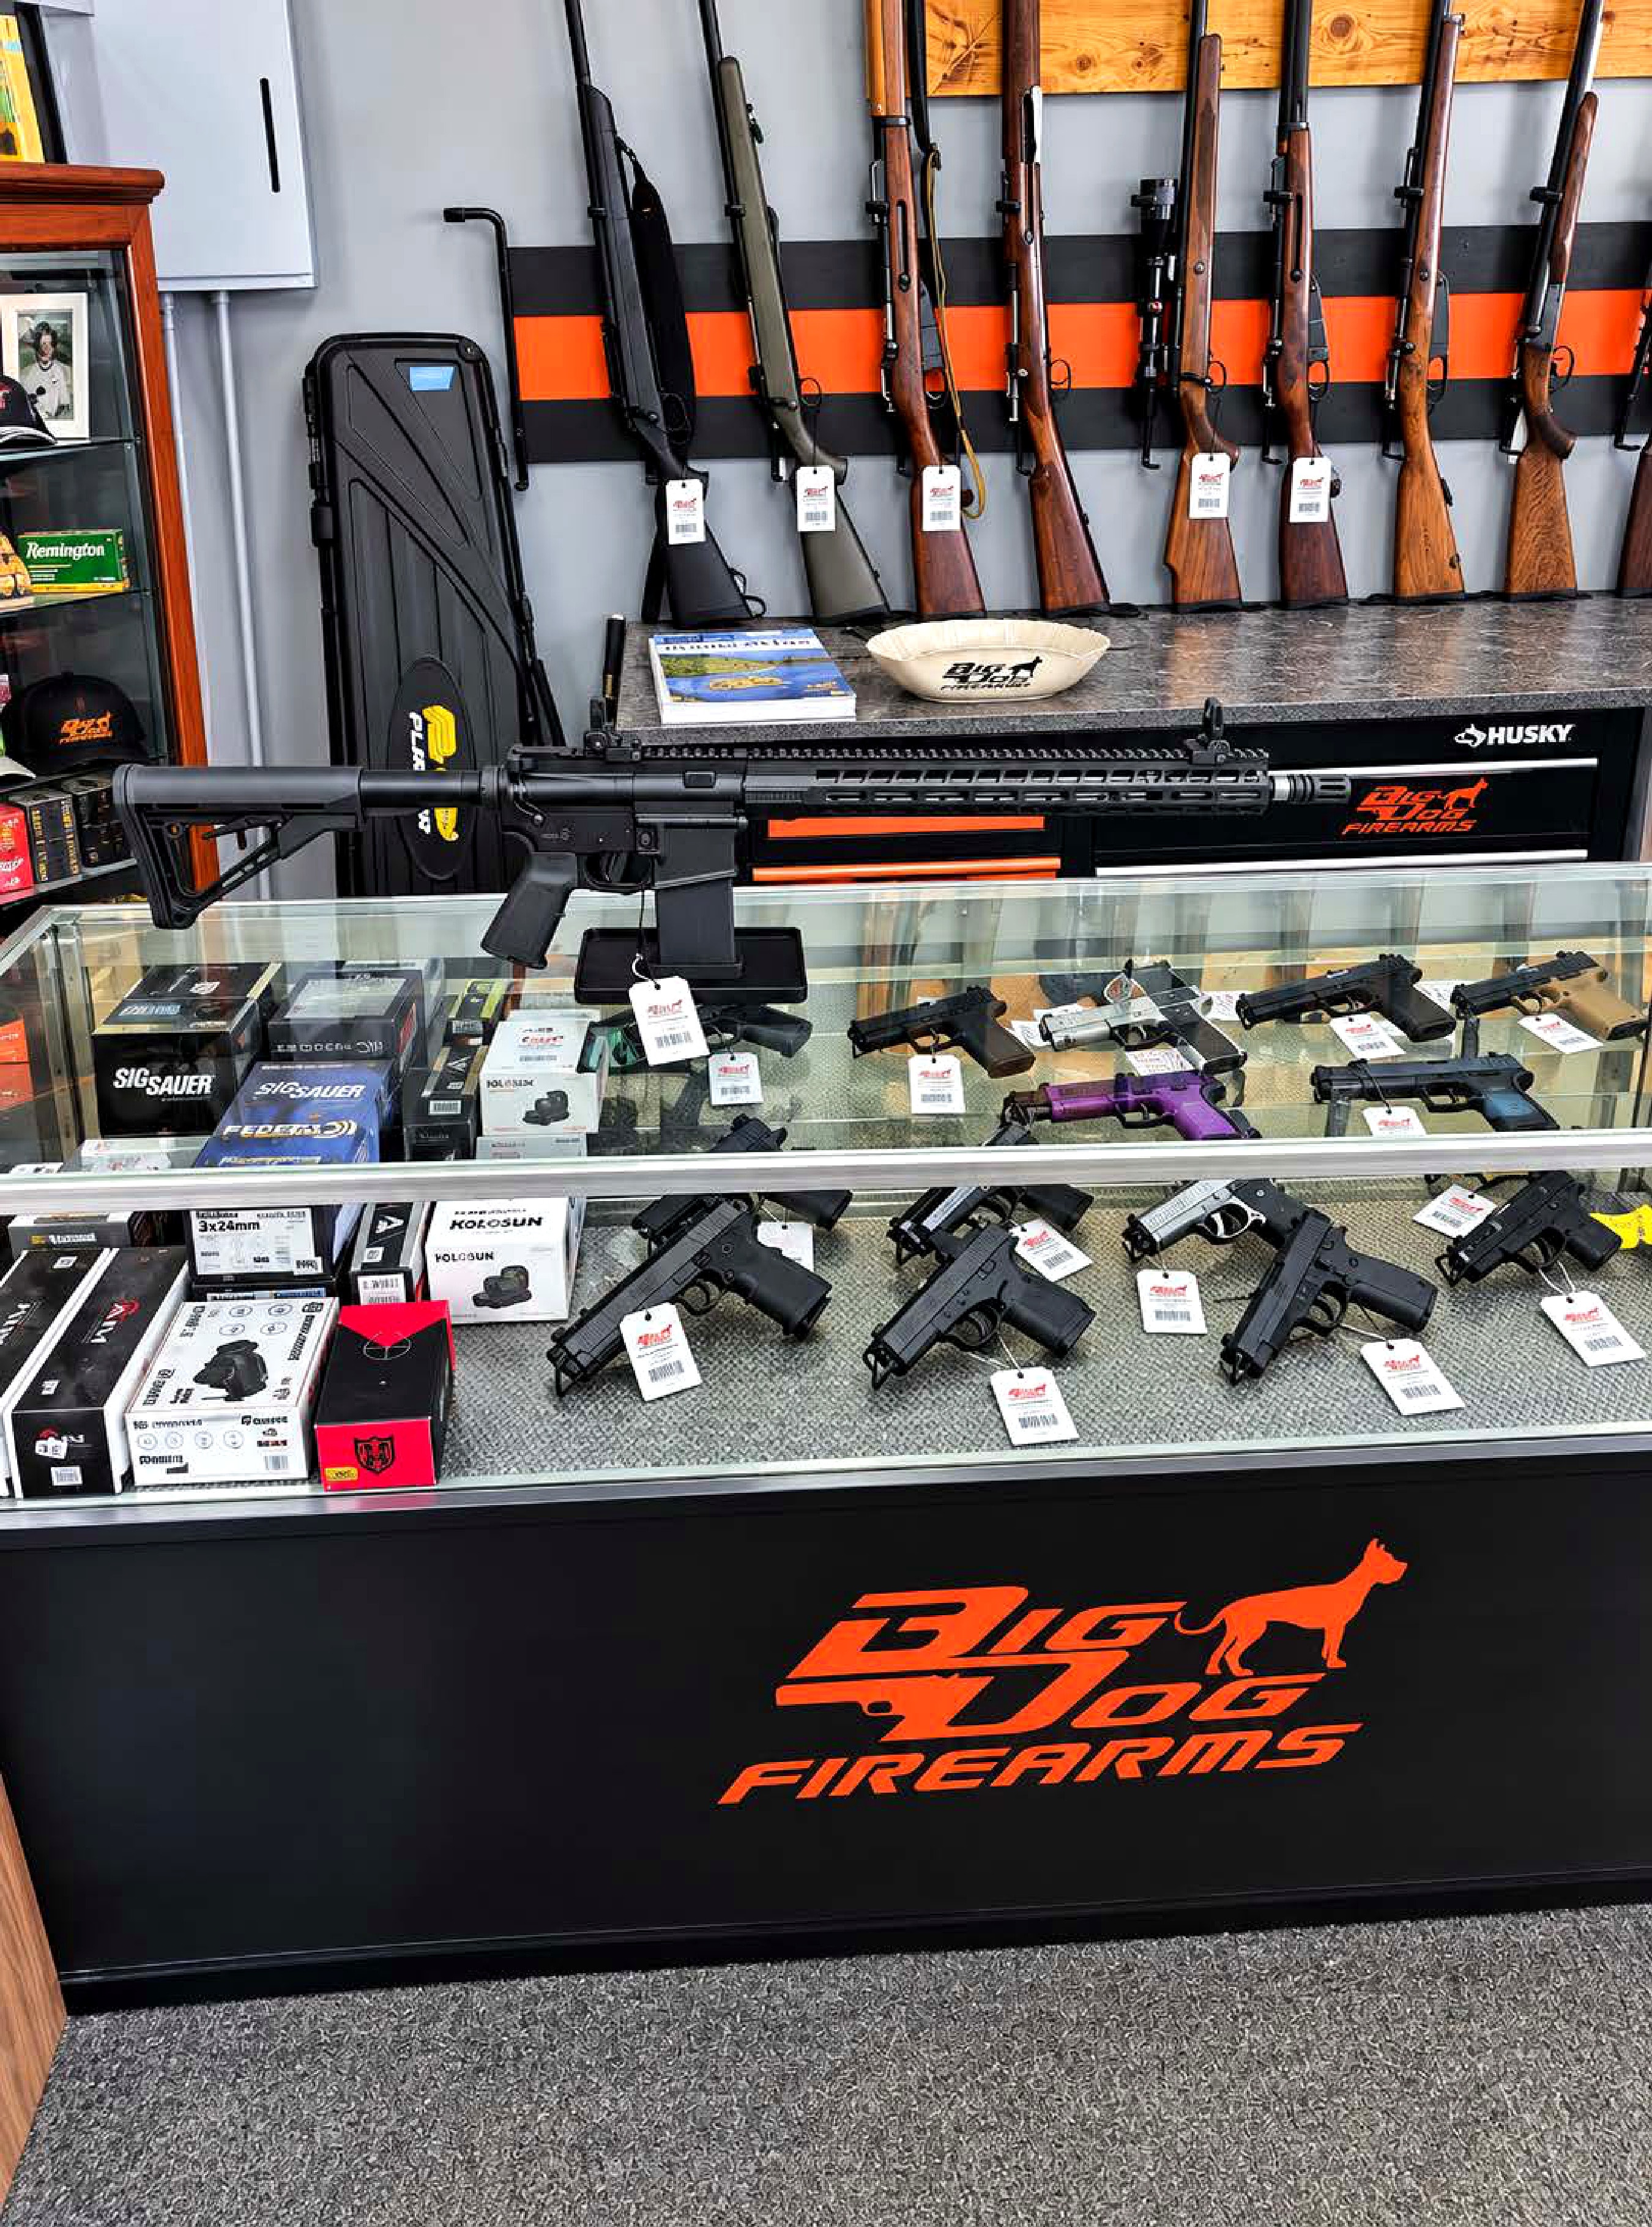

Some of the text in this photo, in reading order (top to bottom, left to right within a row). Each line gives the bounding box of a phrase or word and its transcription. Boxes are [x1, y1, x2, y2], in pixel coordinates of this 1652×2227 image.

[26, 541, 105, 560] Remington
[1487, 724, 1575, 745] HUSKY
[1360, 786, 1444, 806] BIG
[1342, 820, 1477, 835] FIREARMS
[113, 1068, 215, 1095] SIG SAUER
[255, 1081, 366, 1099] SIG SAUER
[198, 1220, 261, 1232] 3x24mm
[787, 1586, 1187, 1678] BIG
[776, 1649, 1326, 1742] DOG
[718, 1723, 1363, 1804] FIREARMS
